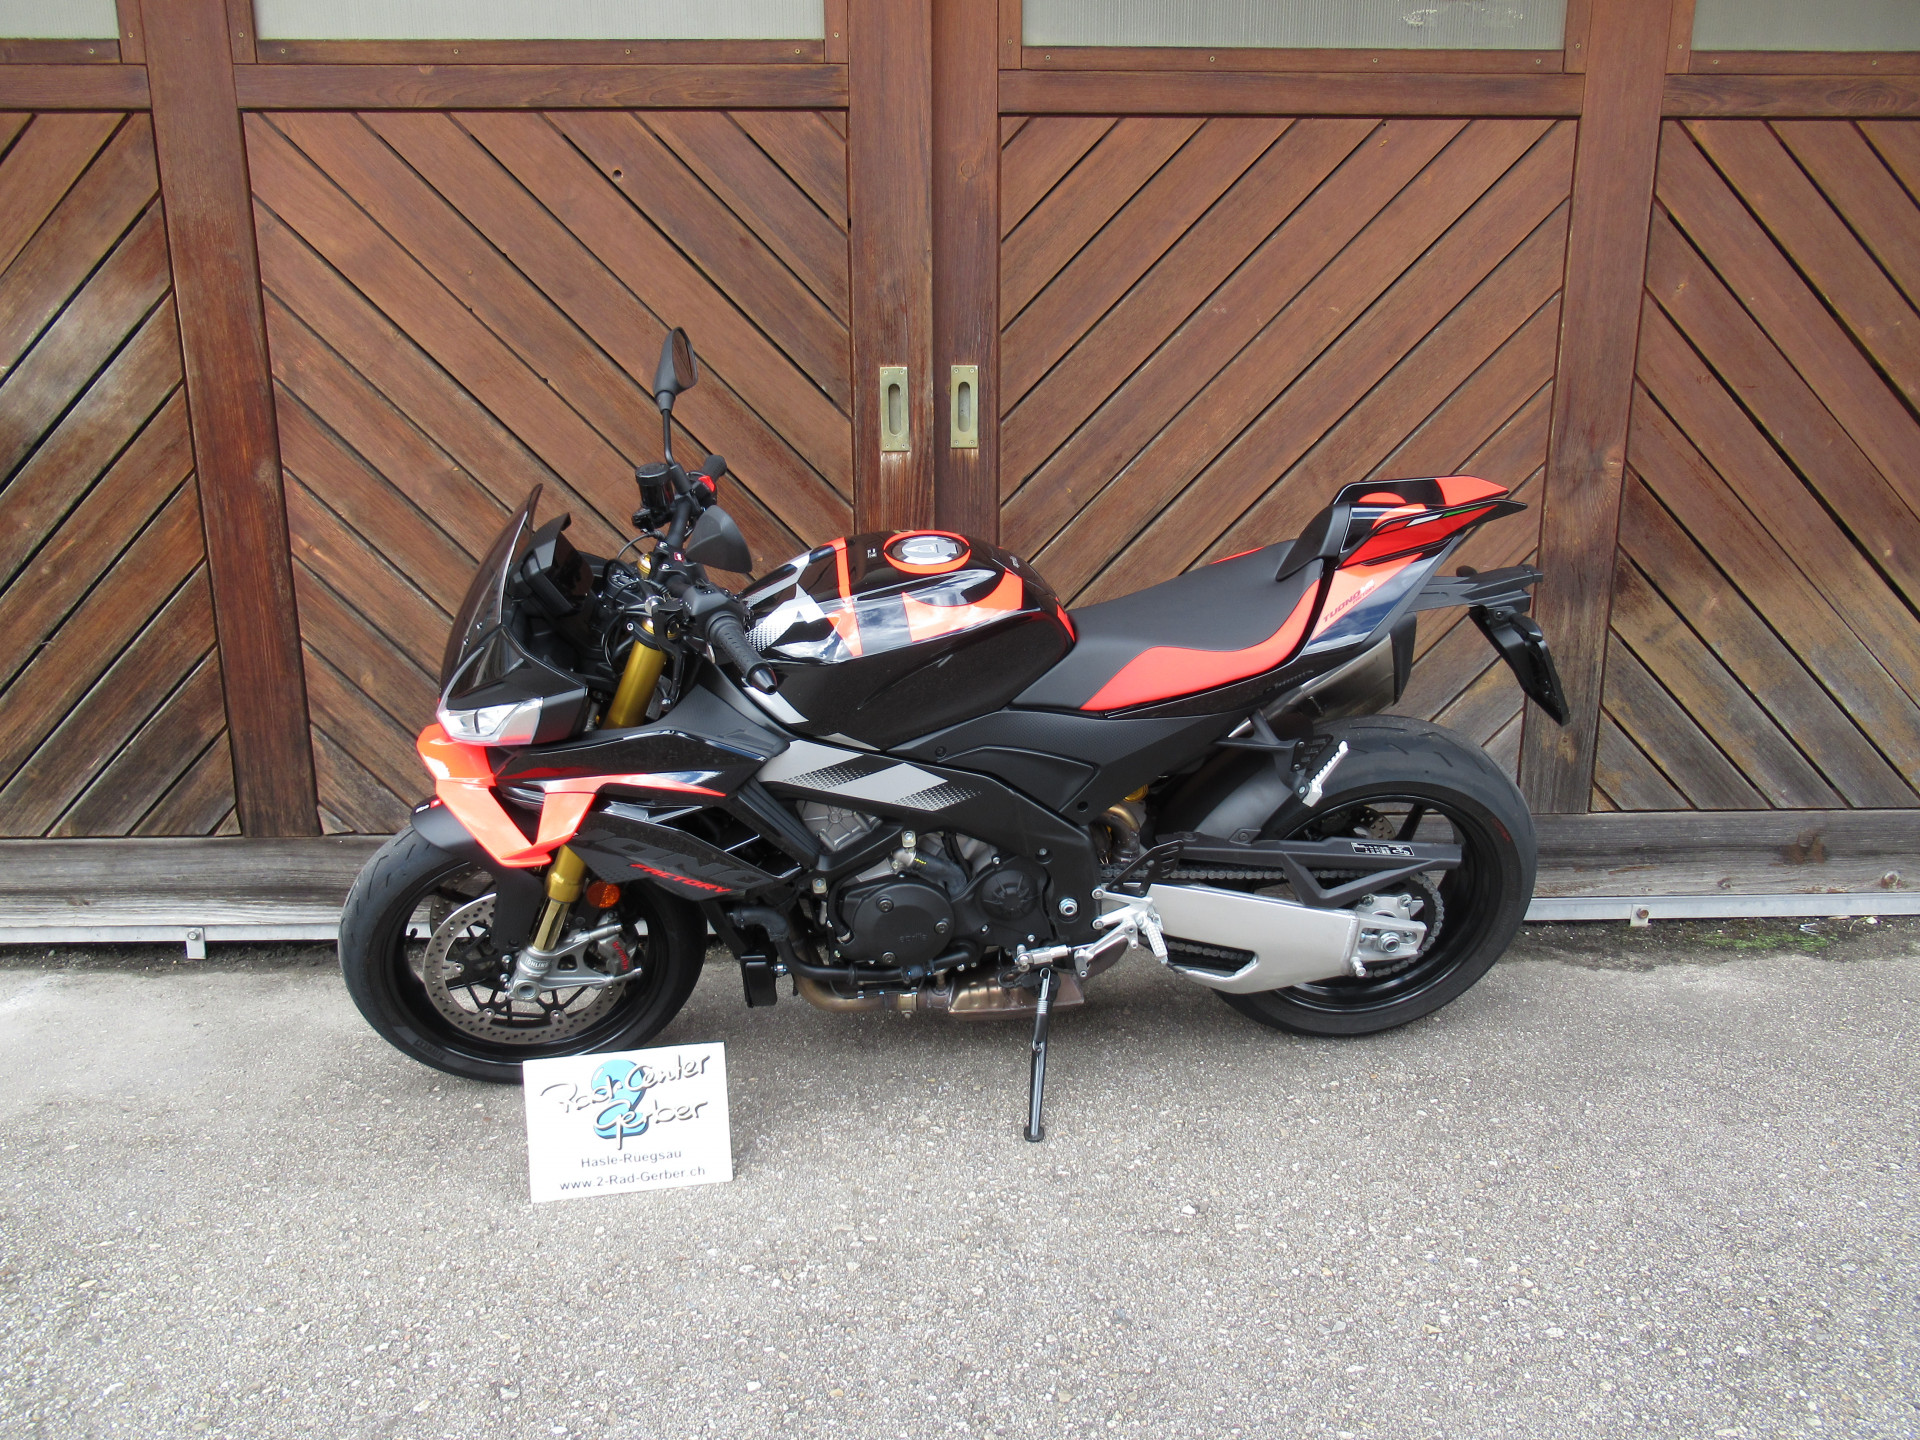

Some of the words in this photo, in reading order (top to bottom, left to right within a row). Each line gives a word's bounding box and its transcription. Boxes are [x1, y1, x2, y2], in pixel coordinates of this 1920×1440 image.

[1324, 590, 1361, 622] TUONO
[628, 863, 732, 893] FACTORY
[624, 1055, 710, 1091] Center
[594, 1099, 708, 1150] Gerber
[560, 1166, 706, 1190] www.2-Rad-Gerber.ch
